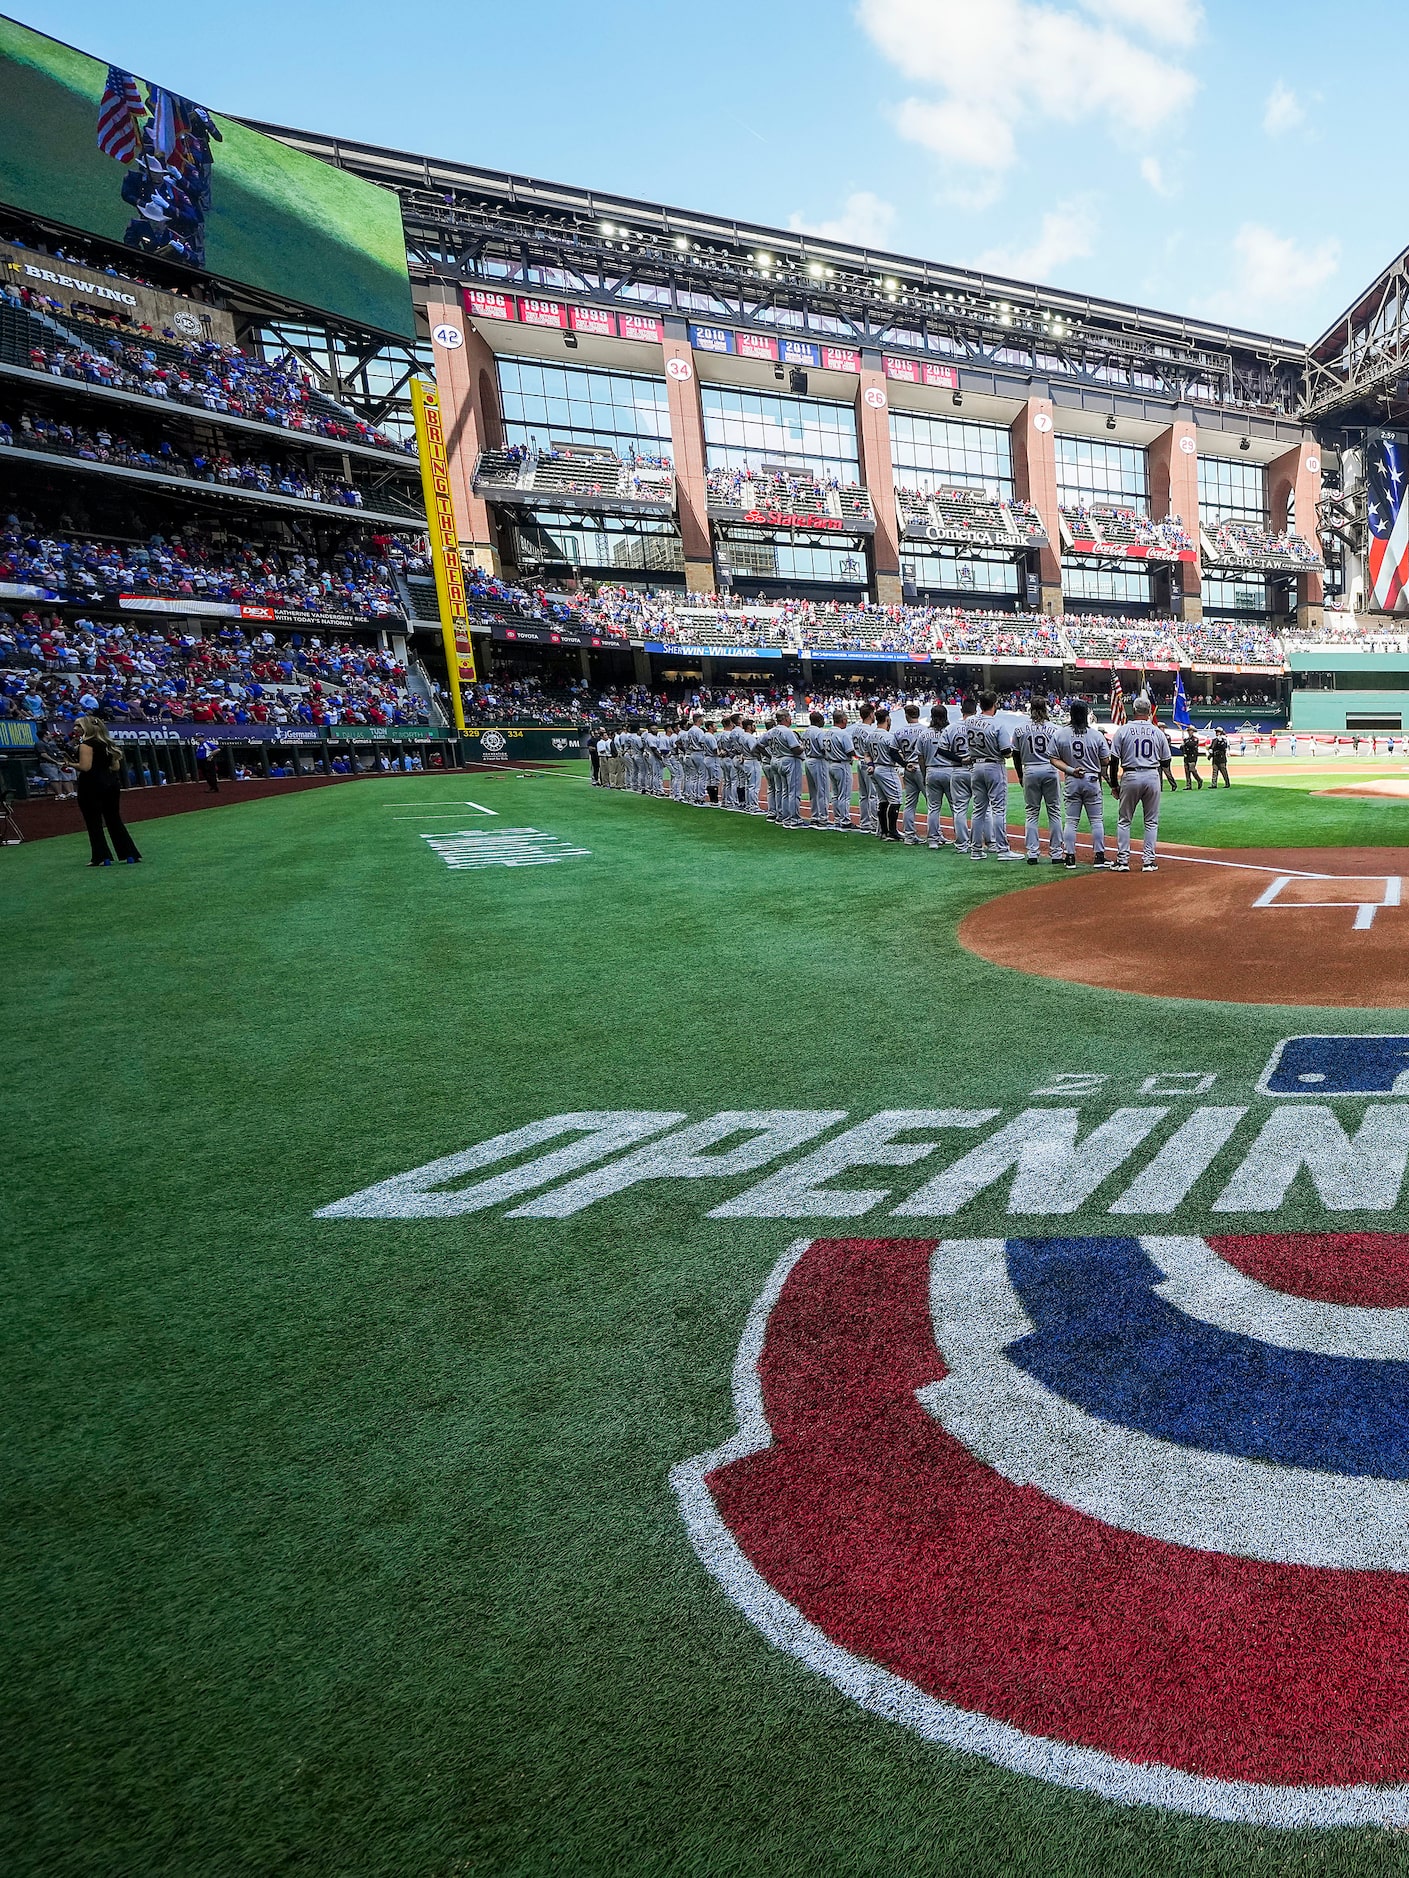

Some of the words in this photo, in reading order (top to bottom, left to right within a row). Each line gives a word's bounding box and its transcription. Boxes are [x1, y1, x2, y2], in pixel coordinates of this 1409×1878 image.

[24, 264, 137, 307] BREWING
[469, 290, 505, 307] 1996
[523, 298, 559, 315] 1998
[574, 306, 608, 323] 1999
[625, 315, 656, 330] 2010
[437, 329, 458, 344] 42
[696, 327, 725, 341] 2010
[743, 334, 769, 348] 2011
[785, 341, 811, 355] 2011
[828, 348, 853, 361] 2012
[670, 364, 688, 376] 34
[887, 358, 912, 371] 2015
[927, 364, 951, 377] 2016
[867, 392, 883, 404] 26
[1039, 417, 1047, 428] 7
[1381, 431, 1396, 440] 2:59
[1181, 440, 1194, 451] 29
[1308, 460, 1318, 470] 10
[426, 408, 448, 494] BRING
[437, 498, 455, 547] THE
[446, 551, 464, 617] HEAT
[996, 532, 1031, 546] Bank
[1228, 555, 1282, 570] CHOCTAW
[243, 606, 269, 615] DEX
[274, 609, 310, 618] KATHERINE
[293, 616, 320, 624] TODAY'S
[321, 618, 353, 627] NATIONAL
[517, 632, 539, 640] TOYOTA
[561, 636, 581, 644] TOYOTA
[601, 640, 620, 648] TOYOTA
[108, 725, 181, 740] rmania
[287, 729, 317, 739] Germania
[342, 731, 364, 739] DALLAS
[463, 730, 480, 738] 329
[507, 730, 524, 738] 334
[1014, 724, 1057, 737] BLACKMO
[1130, 727, 1155, 736] BLACK
[967, 730, 986, 748] 23
[1027, 735, 1047, 754] 19
[1072, 740, 1085, 760] 9
[1133, 738, 1153, 759] 10
